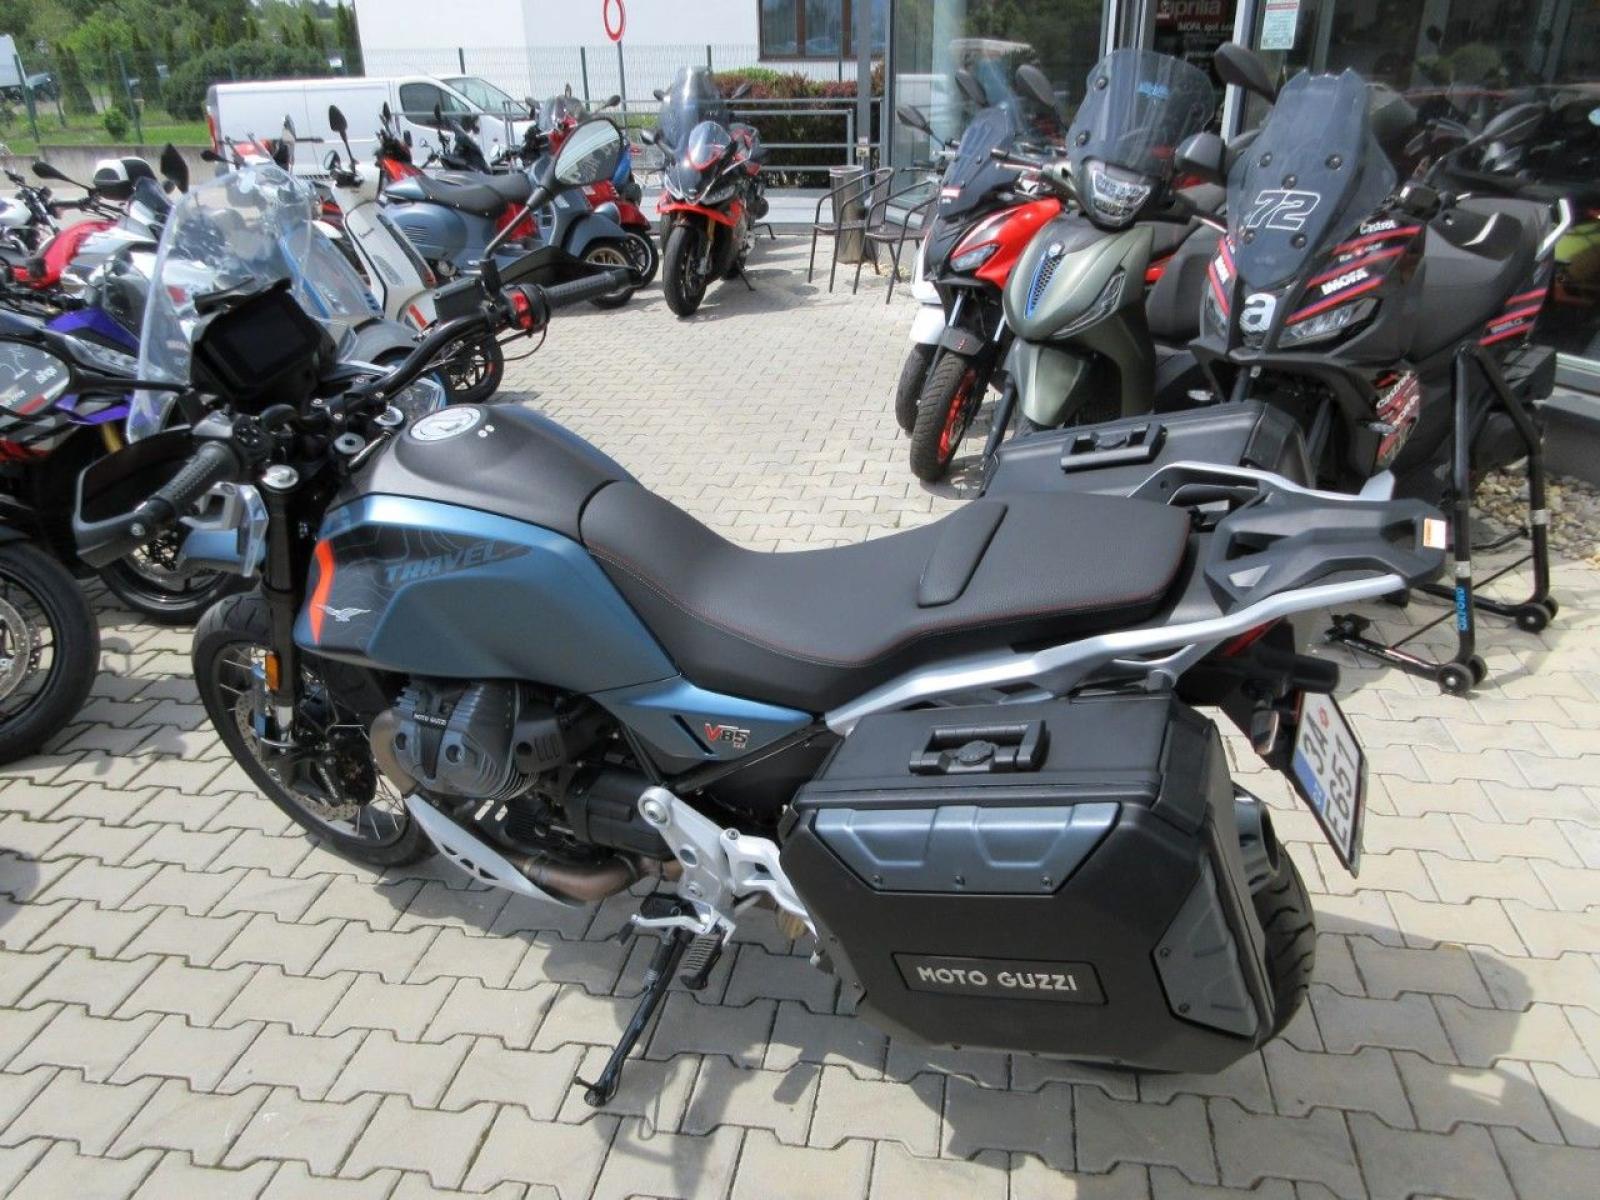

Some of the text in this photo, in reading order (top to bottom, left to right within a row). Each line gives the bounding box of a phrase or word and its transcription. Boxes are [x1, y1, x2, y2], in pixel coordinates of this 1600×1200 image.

[1246, 189, 1321, 231] 72
[383, 540, 508, 585] TRAVEL
[704, 722, 751, 743] V85
[1303, 711, 1330, 776] 3A
[916, 965, 1078, 992] MOTO GUZZI
